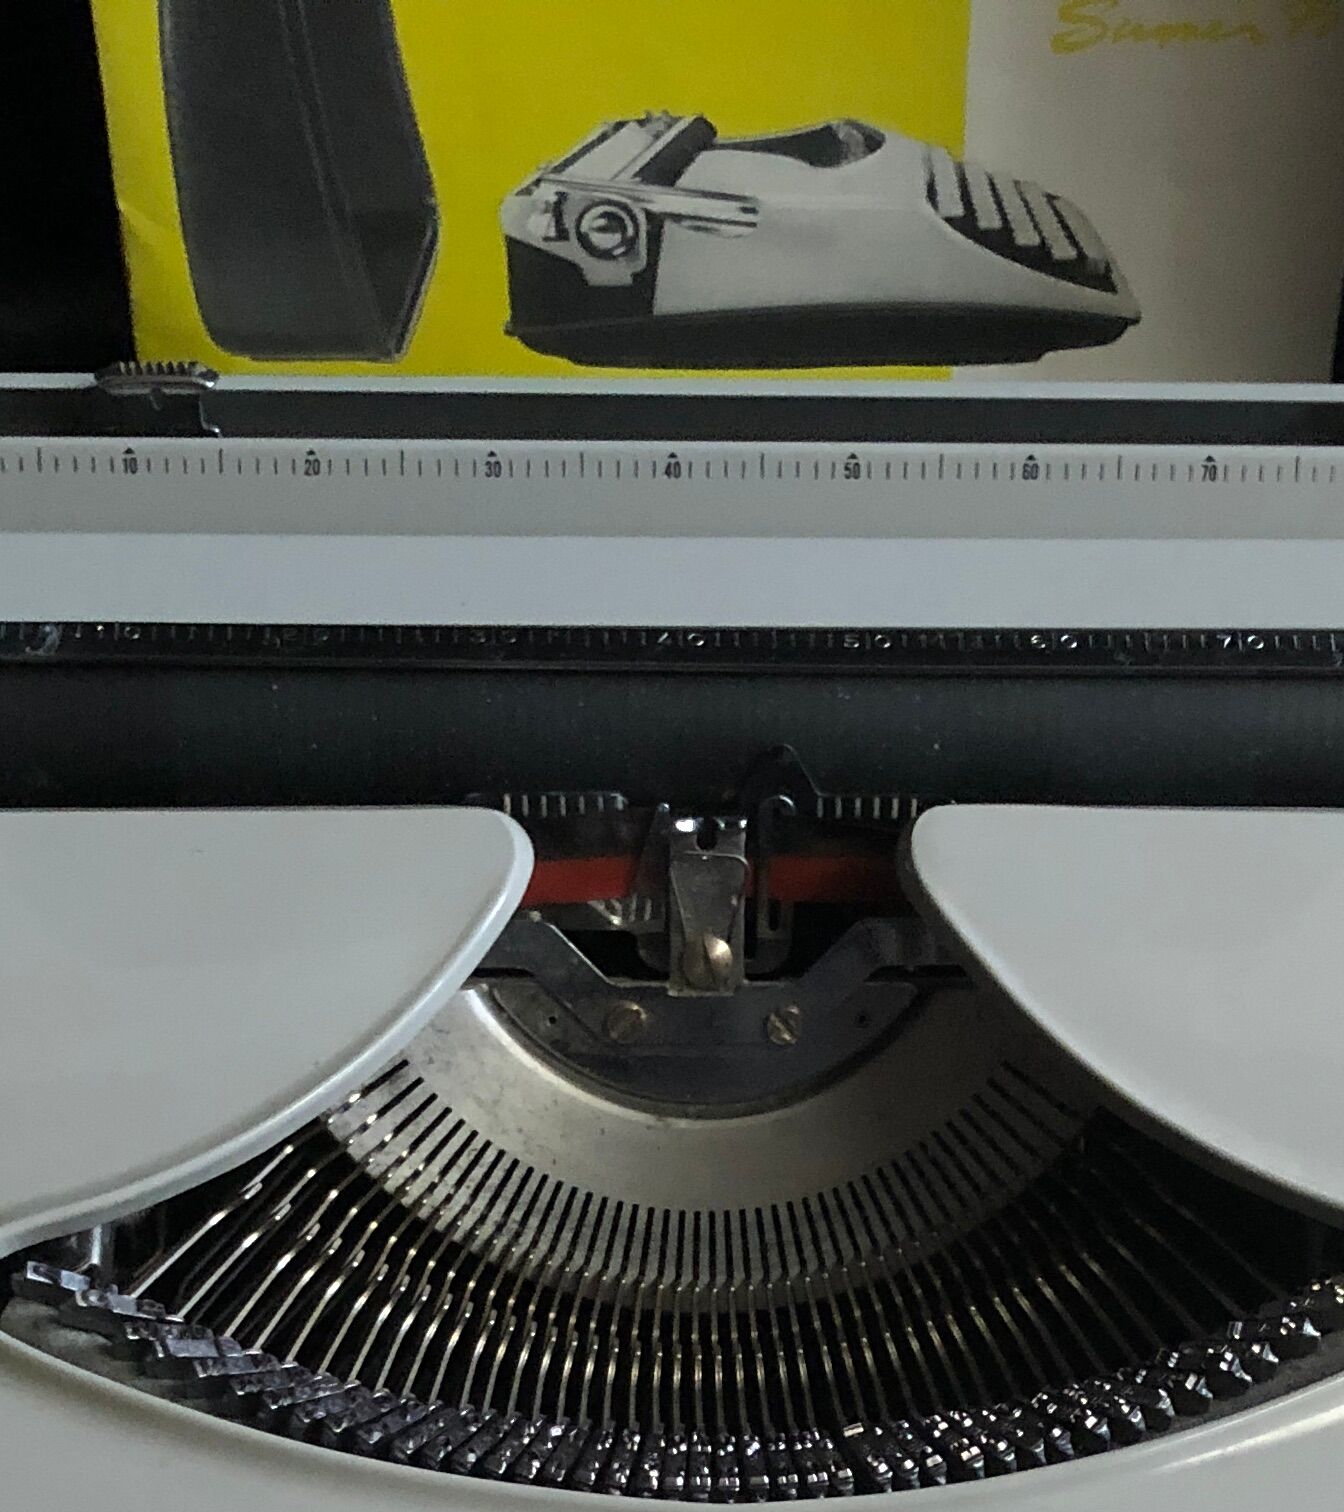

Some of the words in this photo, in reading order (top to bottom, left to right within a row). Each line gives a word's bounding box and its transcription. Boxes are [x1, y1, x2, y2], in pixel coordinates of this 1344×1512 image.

[123, 456, 138, 475] 10
[303, 457, 320, 477] 20
[484, 459, 501, 479] 30
[664, 460, 681, 480] 40
[844, 460, 860, 481] 50
[1200, 463, 1217, 482] 70
